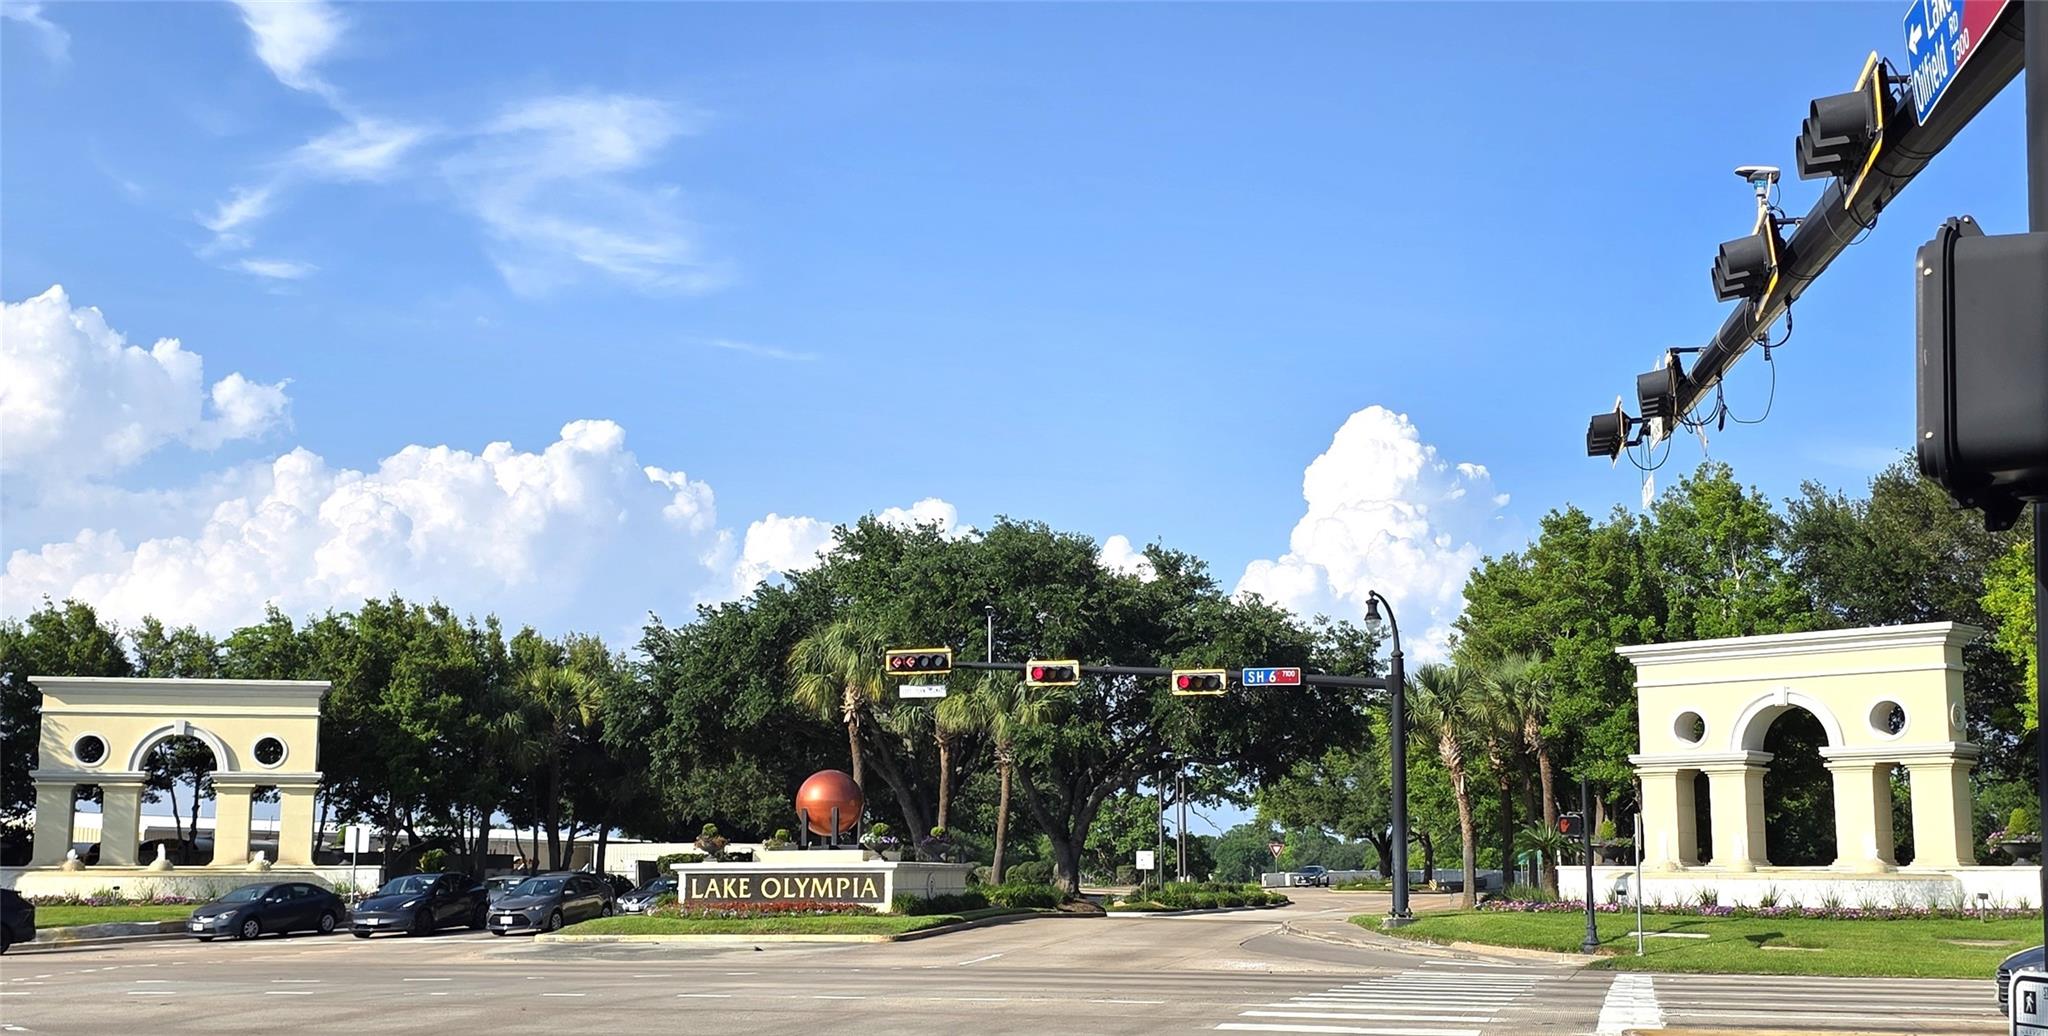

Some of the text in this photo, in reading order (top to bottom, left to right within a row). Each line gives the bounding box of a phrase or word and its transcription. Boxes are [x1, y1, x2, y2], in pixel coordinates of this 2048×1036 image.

[1913, 10, 1959, 112] Oilfield RD
[1951, 27, 1970, 65] 7300
[1248, 671, 1277, 683] SH 6
[691, 877, 878, 899] LAKE OLYMPIA
